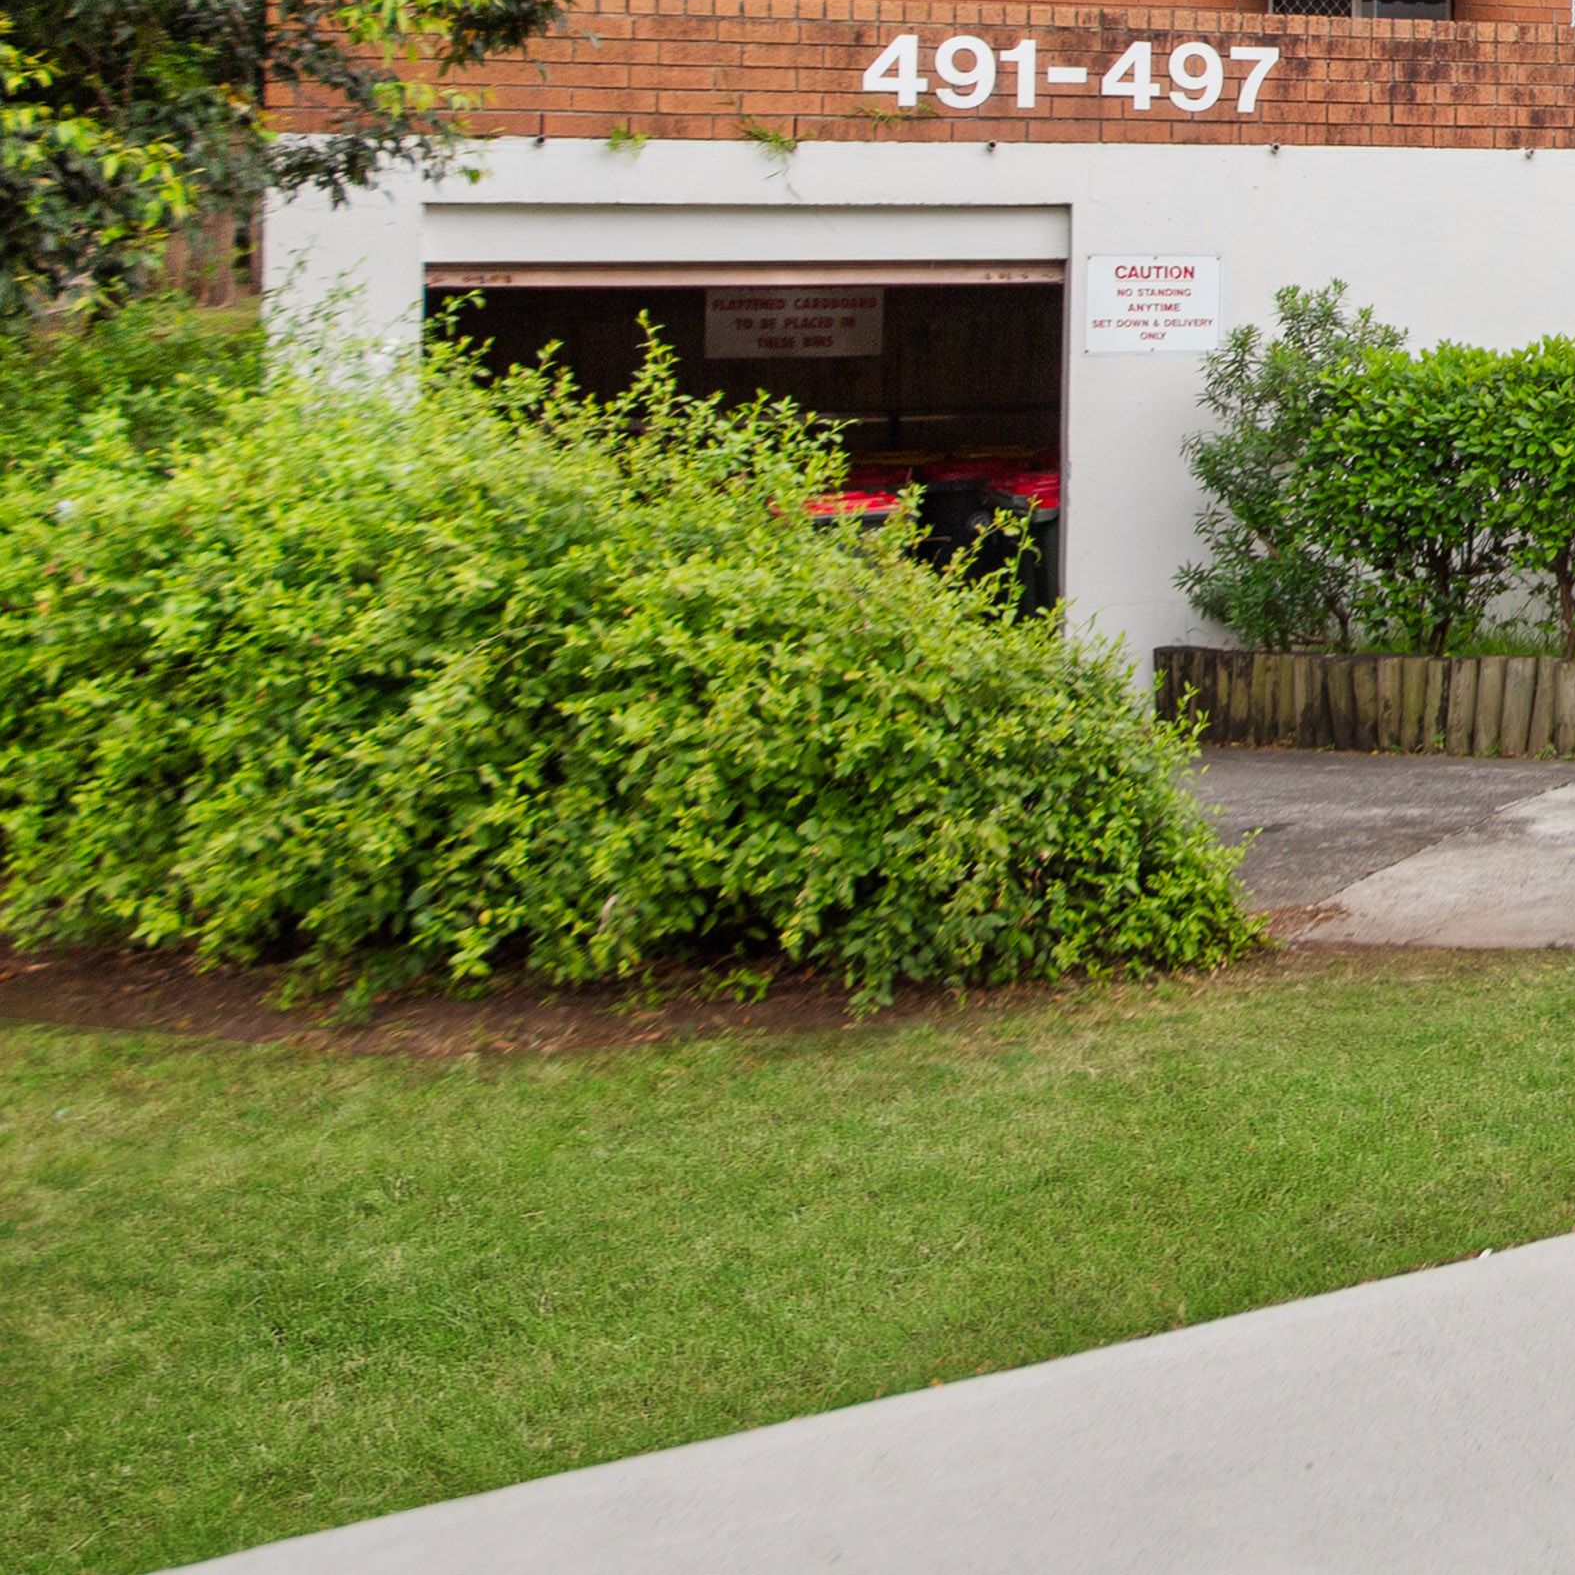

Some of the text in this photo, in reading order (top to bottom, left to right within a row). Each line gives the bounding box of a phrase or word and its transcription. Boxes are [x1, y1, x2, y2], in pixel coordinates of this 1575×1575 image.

[862, 34, 1280, 114] 491-497
[1114, 265, 1195, 279] CAUTION
[1117, 288, 1192, 297] NO STANDING
[712, 297, 877, 311] FLATTENED CARDBOARD
[1128, 303, 1181, 312] ANYTIME
[735, 317, 754, 329] TO
[784, 316, 833, 329] PLACED
[1092, 318, 1214, 328] SET DOWN & DELIVERY
[1140, 332, 1167, 340] ONLY
